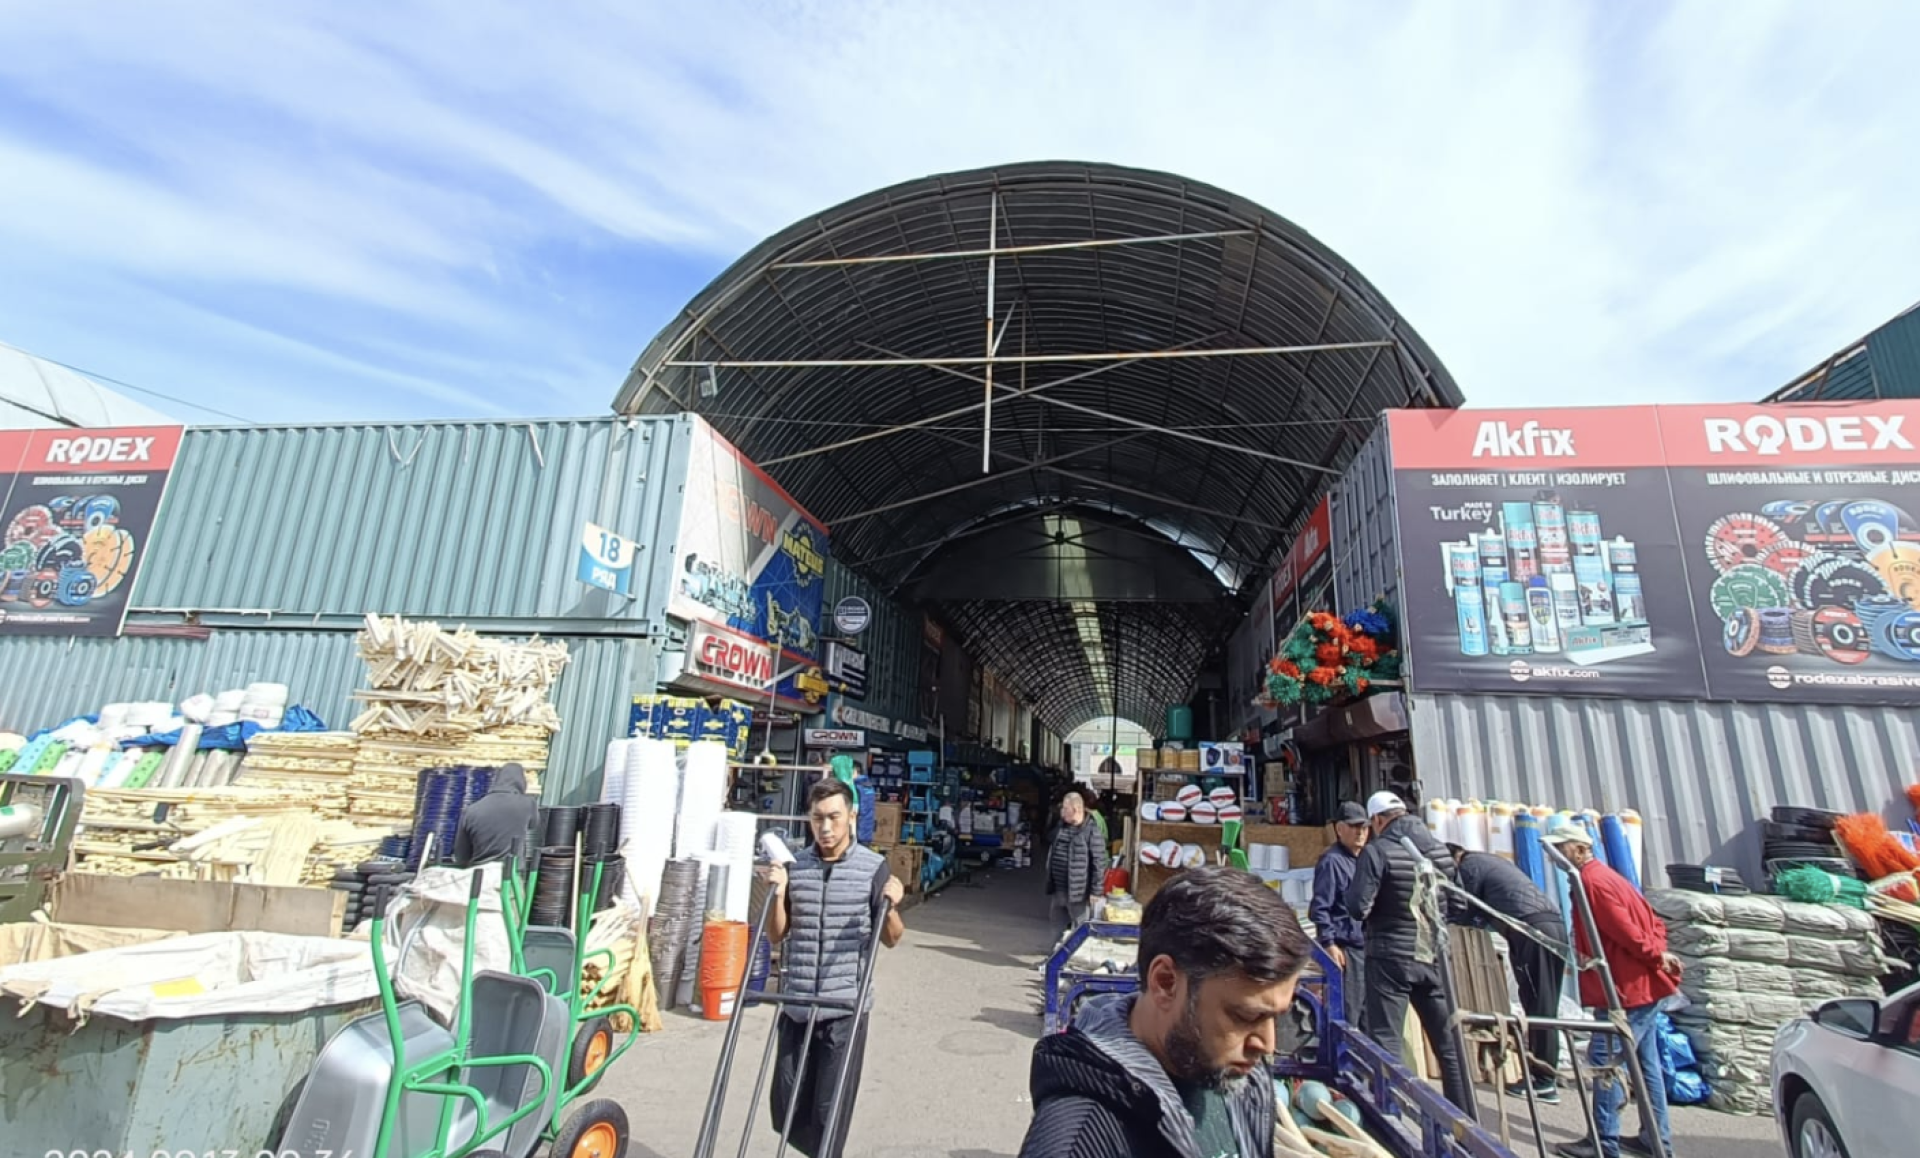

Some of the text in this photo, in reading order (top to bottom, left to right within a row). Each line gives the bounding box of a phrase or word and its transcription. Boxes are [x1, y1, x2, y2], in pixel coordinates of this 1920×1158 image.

[1472, 421, 1577, 457] Akfix
[1704, 415, 1915, 455] RODEX
[46, 436, 155, 464] RODEX
[1431, 473, 1499, 486] ЗАПОЛНЯЕТ
[1557, 472, 1627, 487] ИЗОЛИРУЕТ
[1706, 470, 1920, 486] ШЛИФОВАЛЬНЫЕ И ОТРЕЗНЫЕ ДИС
[1430, 506, 1492, 523] Turkey
[600, 532, 620, 563] 18
[702, 635, 772, 681] CROWN
[1532, 666, 1600, 678] akfix.com
[812, 730, 858, 741] CROWN
